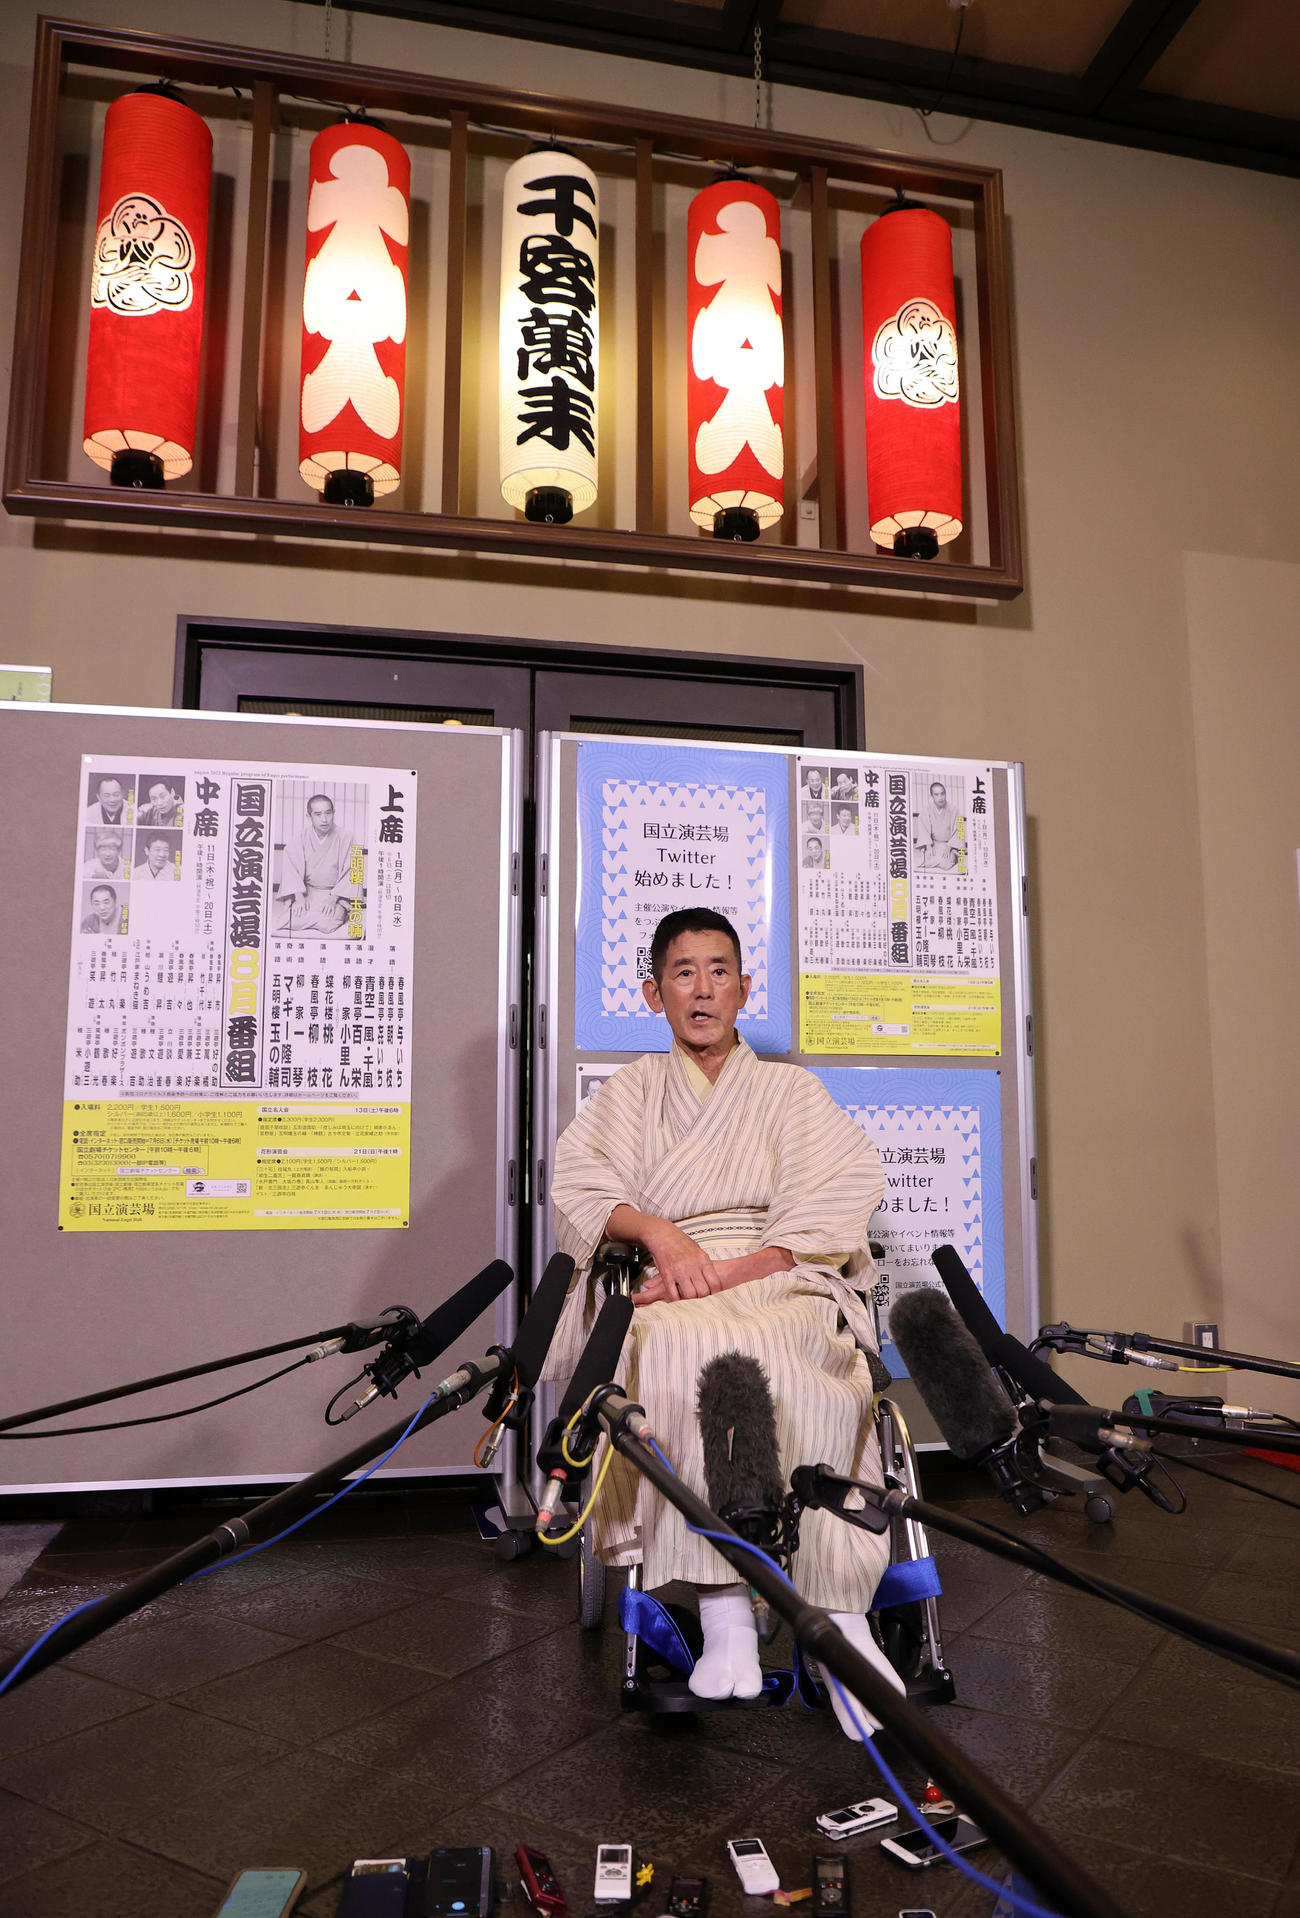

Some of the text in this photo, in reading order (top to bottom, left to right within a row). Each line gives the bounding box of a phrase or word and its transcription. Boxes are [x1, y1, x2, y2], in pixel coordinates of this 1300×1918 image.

[193, 776, 221, 838] 中席
[864, 769, 880, 808] 中席
[972, 776, 986, 814] 上席
[379, 783, 405, 844] 上席
[643, 822, 729, 843] 国立演芸場
[656, 848, 716, 865] Twitter
[634, 870, 736, 890] 始めました！
[280, 976, 294, 1088] マギー隆司
[293, 975, 305, 1088] 柳家一琴
[307, 975, 320, 1088] 春風亭柳枝
[340, 975, 352, 1088] 柳家小里ん
[351, 976, 363, 1088] 春風亭百栄
[816, 1037, 855, 1046] 国立演芸場
[876, 1147, 946, 1165] 立演芸場
[884, 1174, 933, 1188] witter
[89, 1203, 155, 1216] 国立演芸場
